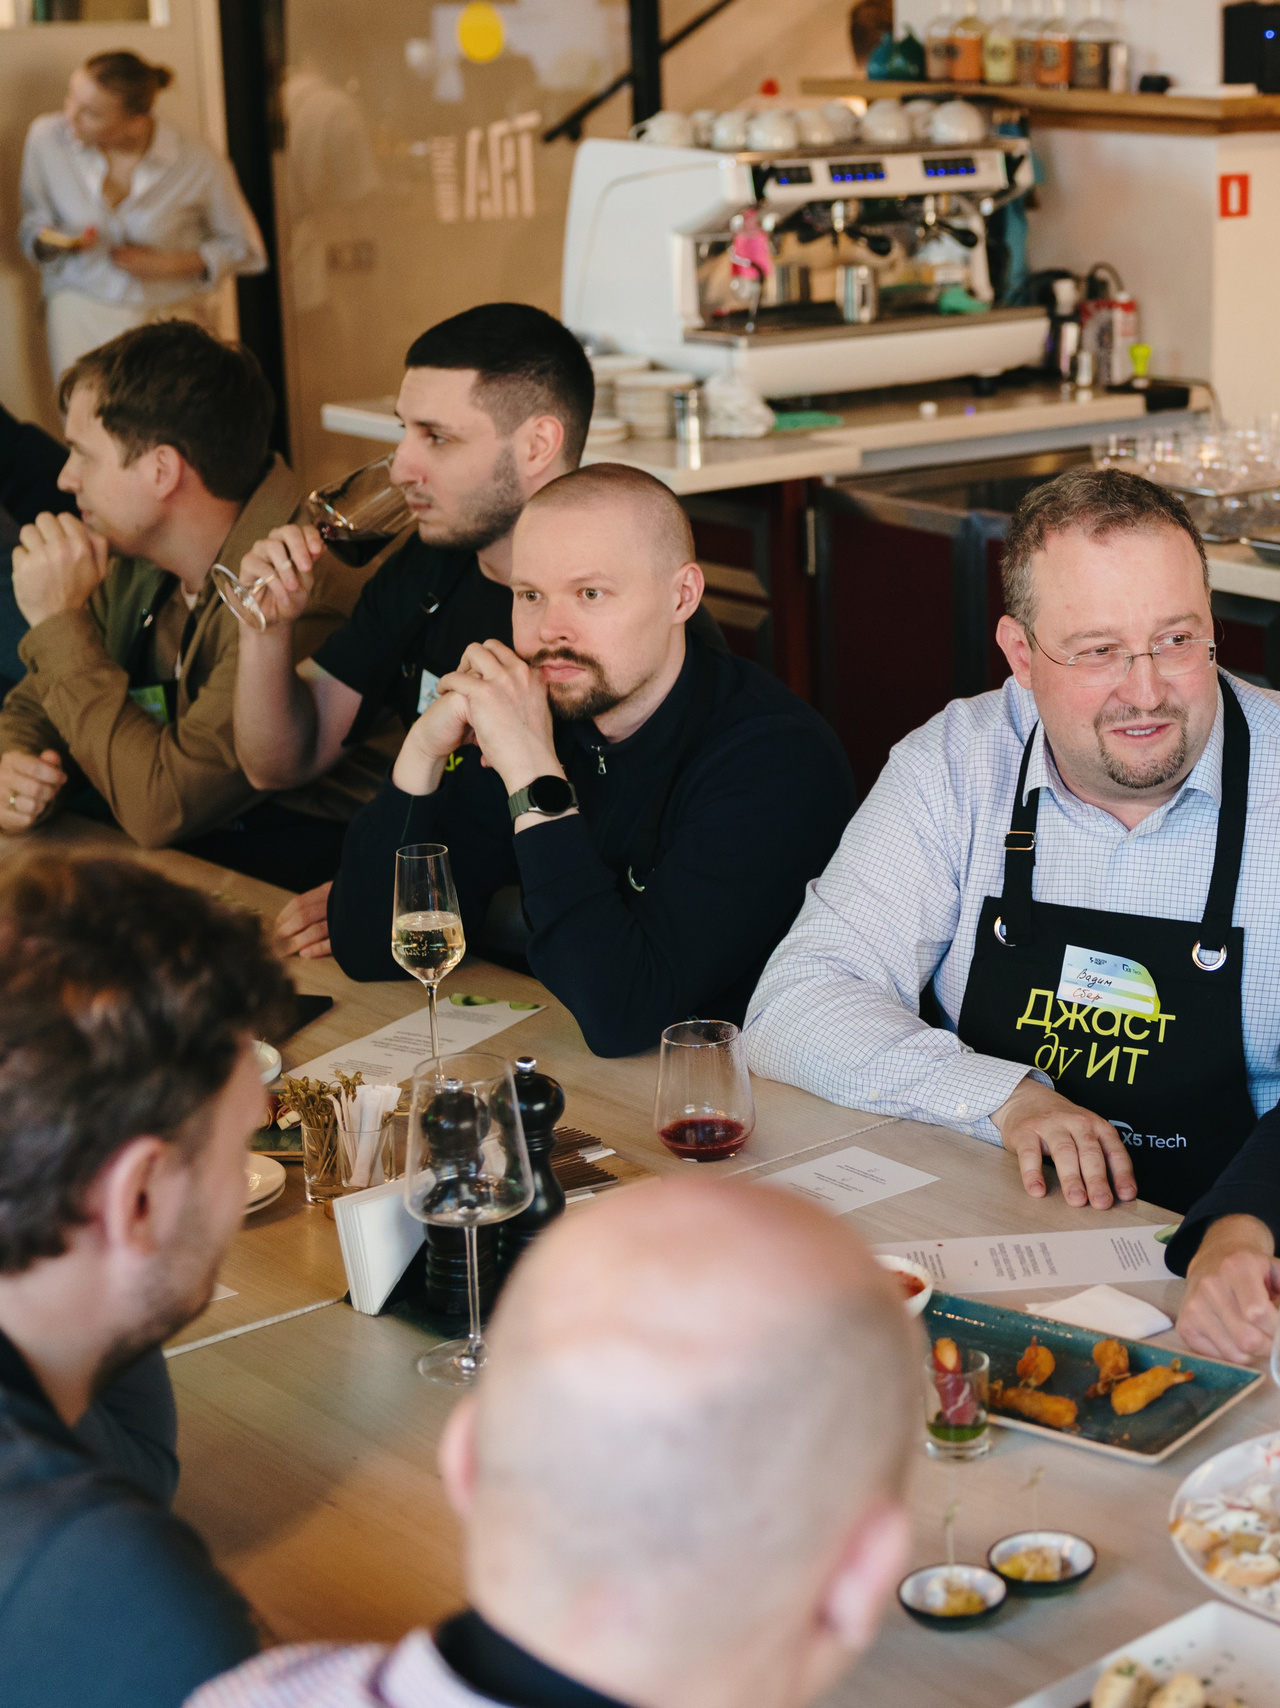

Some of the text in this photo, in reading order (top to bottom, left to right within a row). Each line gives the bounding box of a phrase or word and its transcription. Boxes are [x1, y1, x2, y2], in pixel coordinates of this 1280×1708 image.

[1077, 968, 1113, 988] Вадим
[1073, 987, 1103, 1003] Сбер
[1016, 988, 1176, 1043] Джаст
[1034, 1032, 1149, 1085] ду ИТ
[1121, 1131, 1187, 1148] X5 Tech
